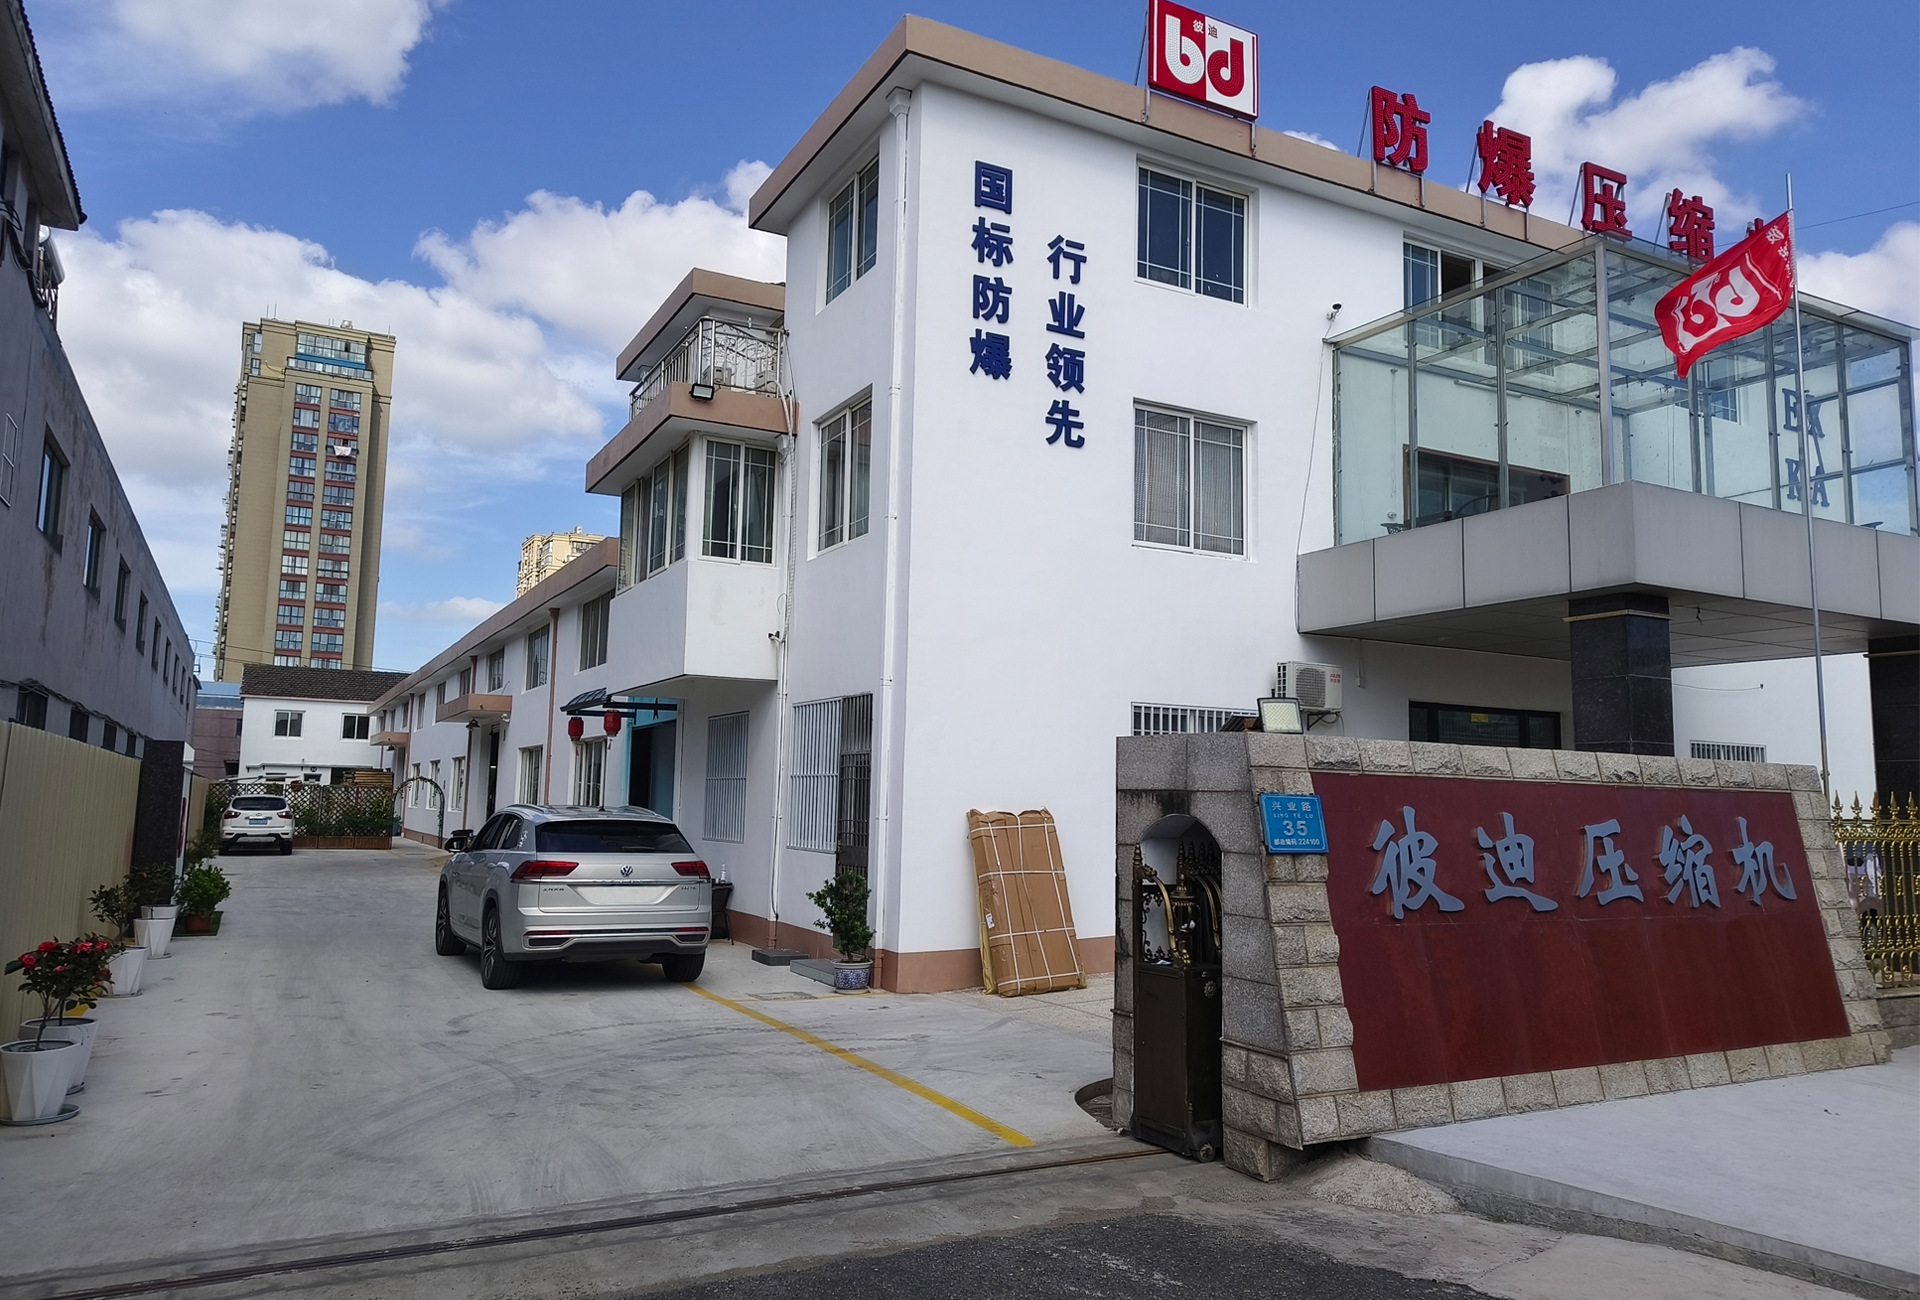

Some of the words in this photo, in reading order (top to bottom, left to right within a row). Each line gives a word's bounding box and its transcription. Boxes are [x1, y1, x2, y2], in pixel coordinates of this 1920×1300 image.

[1193, 19, 1218, 39] 彼迪
[1371, 85, 1764, 263] 防爆压缩
[969, 160, 1014, 380] 国标防爆
[1045, 234, 1087, 449] 行业领先
[1272, 801, 1311, 812] 兴业路
[1282, 820, 1308, 836] 35
[1372, 806, 1797, 919] 彼迪压缩机
